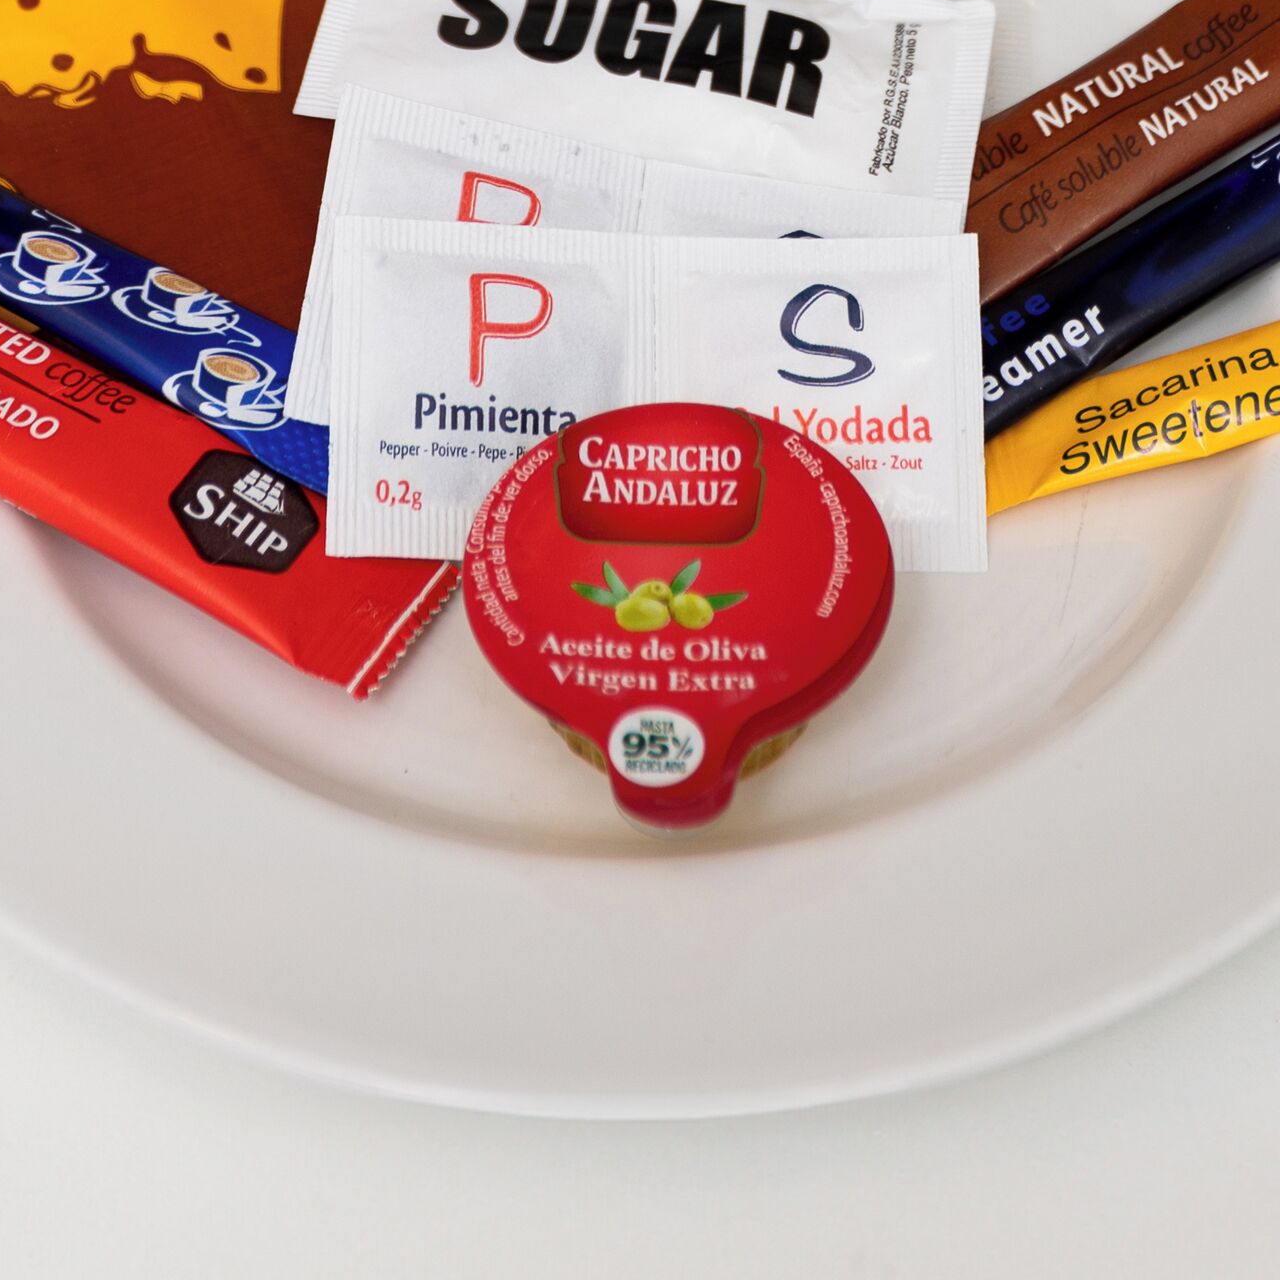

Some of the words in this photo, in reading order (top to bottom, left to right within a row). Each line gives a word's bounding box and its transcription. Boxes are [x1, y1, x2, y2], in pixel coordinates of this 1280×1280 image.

[906, 37, 918, 61] neto
[900, 61, 915, 86] Peso
[971, 131, 1029, 182] uble
[1031, 45, 1184, 136] NATURAL
[1181, 0, 1259, 65] coffee
[891, 89, 910, 129] Blanco.
[869, 126, 888, 176] Fabricado
[882, 109, 891, 128] por
[882, 130, 900, 173] Azúcar
[998, 182, 1060, 235] Café
[1058, 132, 1143, 202] soluble
[1138, 57, 1269, 147] NATURAL
[469, 272, 554, 387] P
[778, 283, 876, 387] S
[983, 302, 1106, 404] eamer
[45, 360, 137, 416] coffee
[1074, 346, 1279, 434] Sacarina
[793, 405, 932, 444] Yodada
[379, 440, 421, 460] Pepper
[431, 443, 468, 458] Poivre
[478, 444, 507, 463] Pepe
[578, 436, 741, 471] CAPRICHO
[846, 456, 878, 471] Saltz
[890, 455, 922, 470] Zout
[376, 479, 422, 511] 0,2g
[502, 482, 523, 502] ver
[582, 472, 738, 506] ANDALUZ
[183, 484, 289, 557] SHIP
[783, 434, 824, 479] España
[816, 481, 852, 619] caprichoandaluz.com
[487, 543, 506, 565] del
[471, 562, 490, 589] neta
[494, 567, 518, 602] antes
[476, 591, 525, 647] Cantidad
[539, 635, 632, 661] Aceite
[640, 635, 676, 662] de
[683, 637, 769, 662] Oliva
[549, 664, 658, 695] Virgen
[668, 668, 756, 692] Extra
[623, 733, 694, 760] 95%
